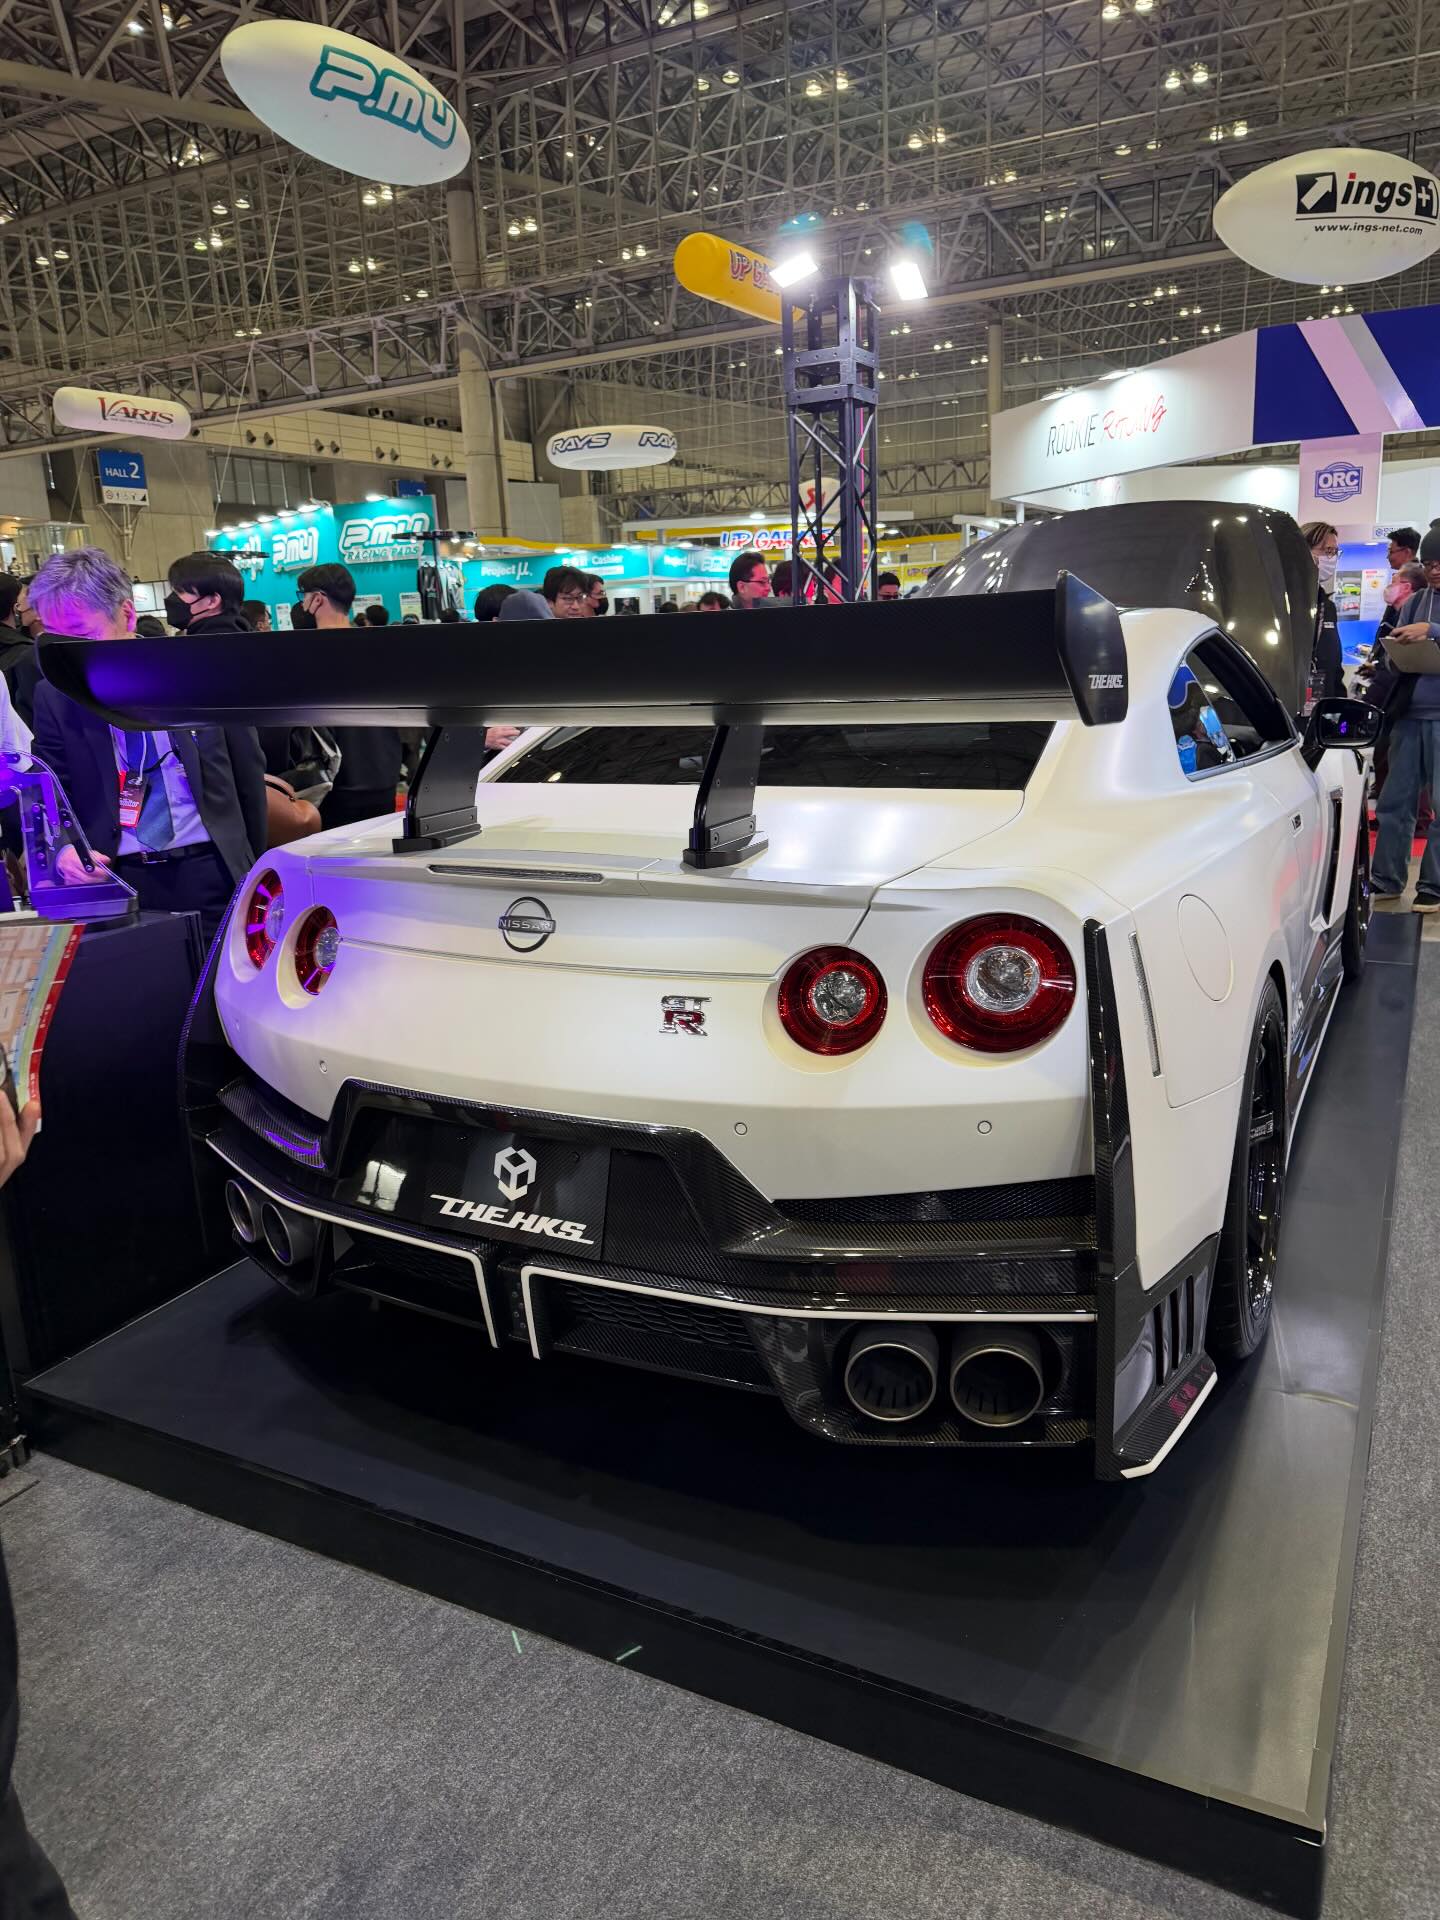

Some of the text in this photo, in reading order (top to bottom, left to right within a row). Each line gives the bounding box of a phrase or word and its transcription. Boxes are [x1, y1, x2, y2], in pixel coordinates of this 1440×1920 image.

[1314, 222, 1423, 235] www.ings-net.com
[97, 397, 174, 424] VARIS
[552, 433, 611, 455] RAYS
[105, 462, 140, 479] HALL 2
[1318, 470, 1359, 489] ORC
[500, 918, 553, 930] NISSAN
